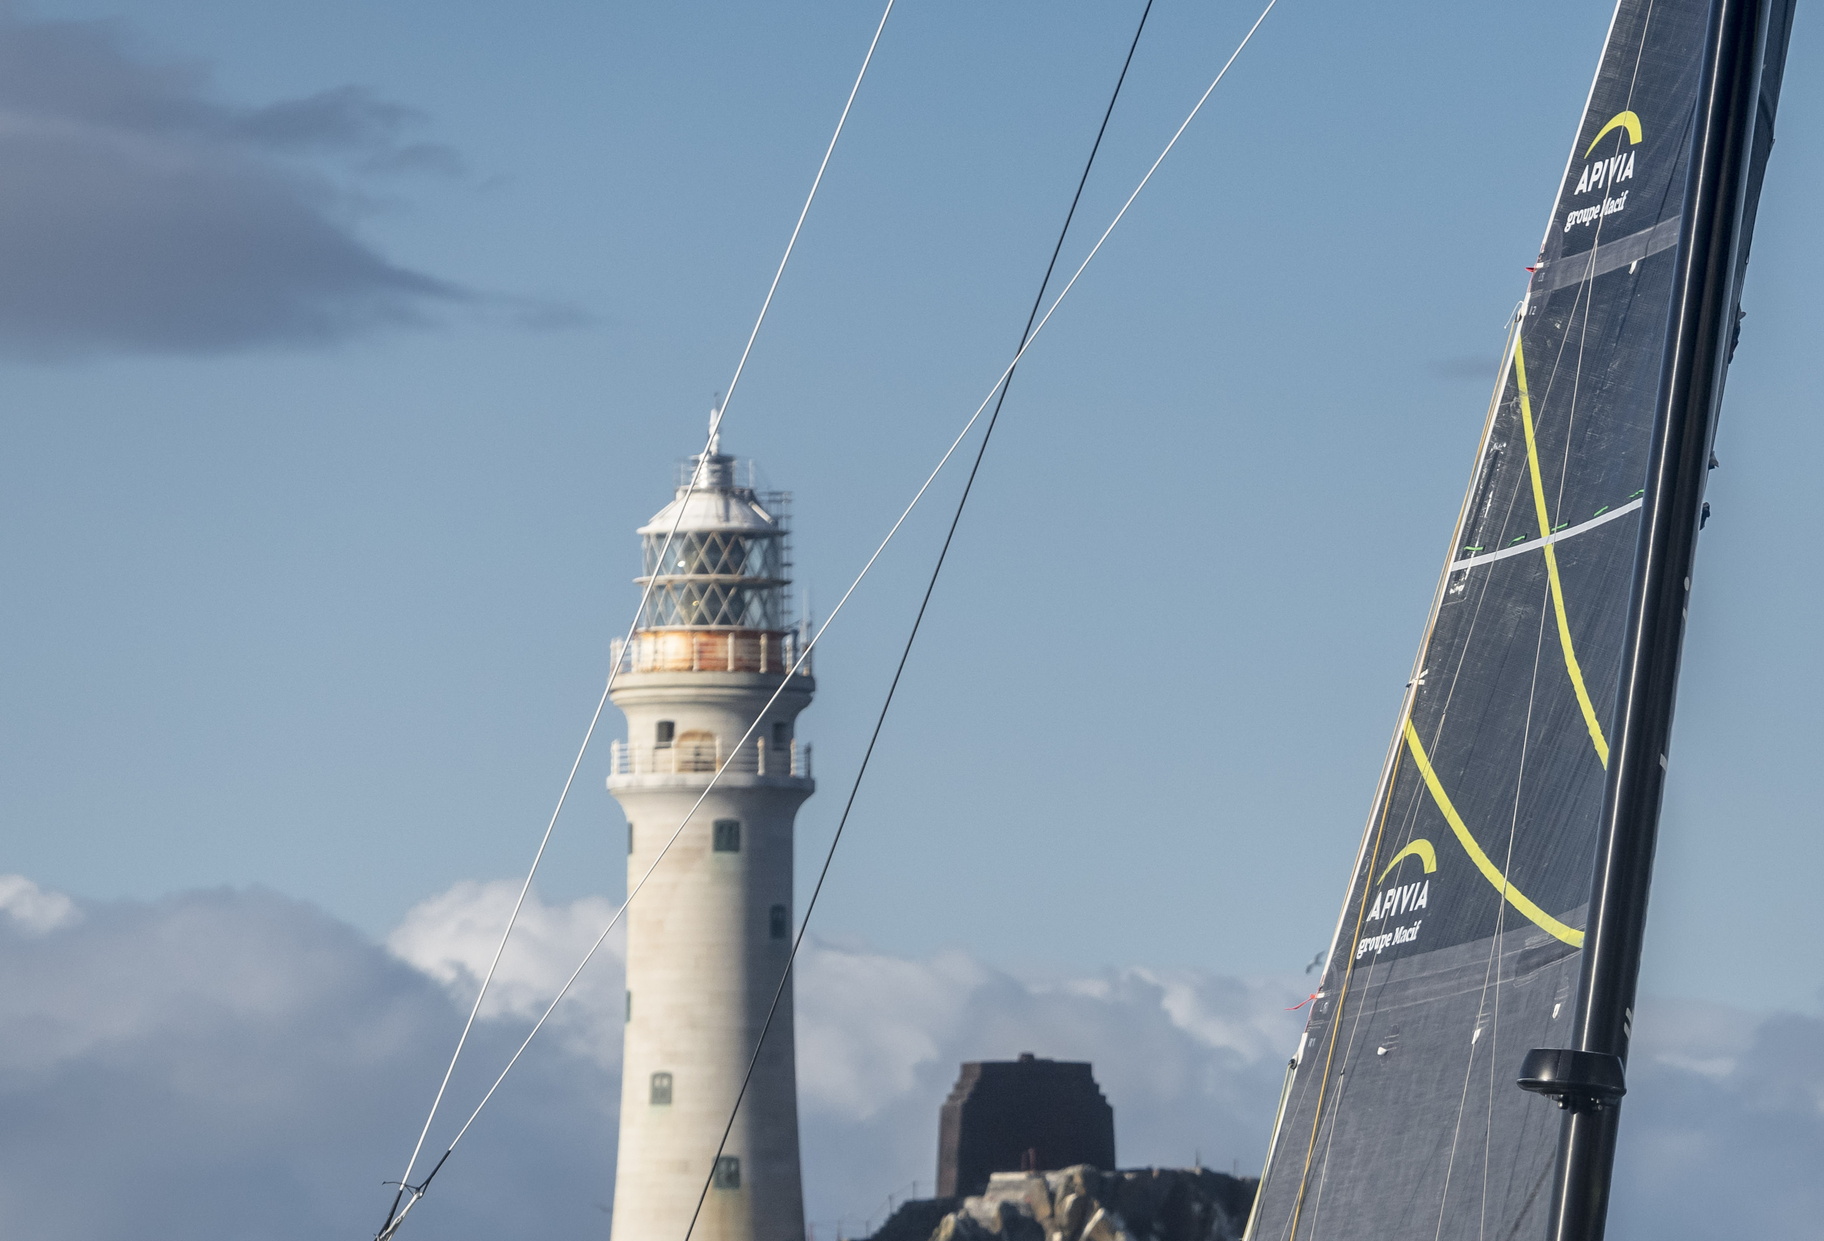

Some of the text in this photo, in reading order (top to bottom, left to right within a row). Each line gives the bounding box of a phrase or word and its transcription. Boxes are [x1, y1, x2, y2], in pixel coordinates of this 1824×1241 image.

[1574, 150, 1635, 195] APIVIA
[1564, 190, 1629, 233] groupe Macif
[1366, 880, 1430, 921] APIVIA
[1356, 920, 1421, 959] groupe Macif
